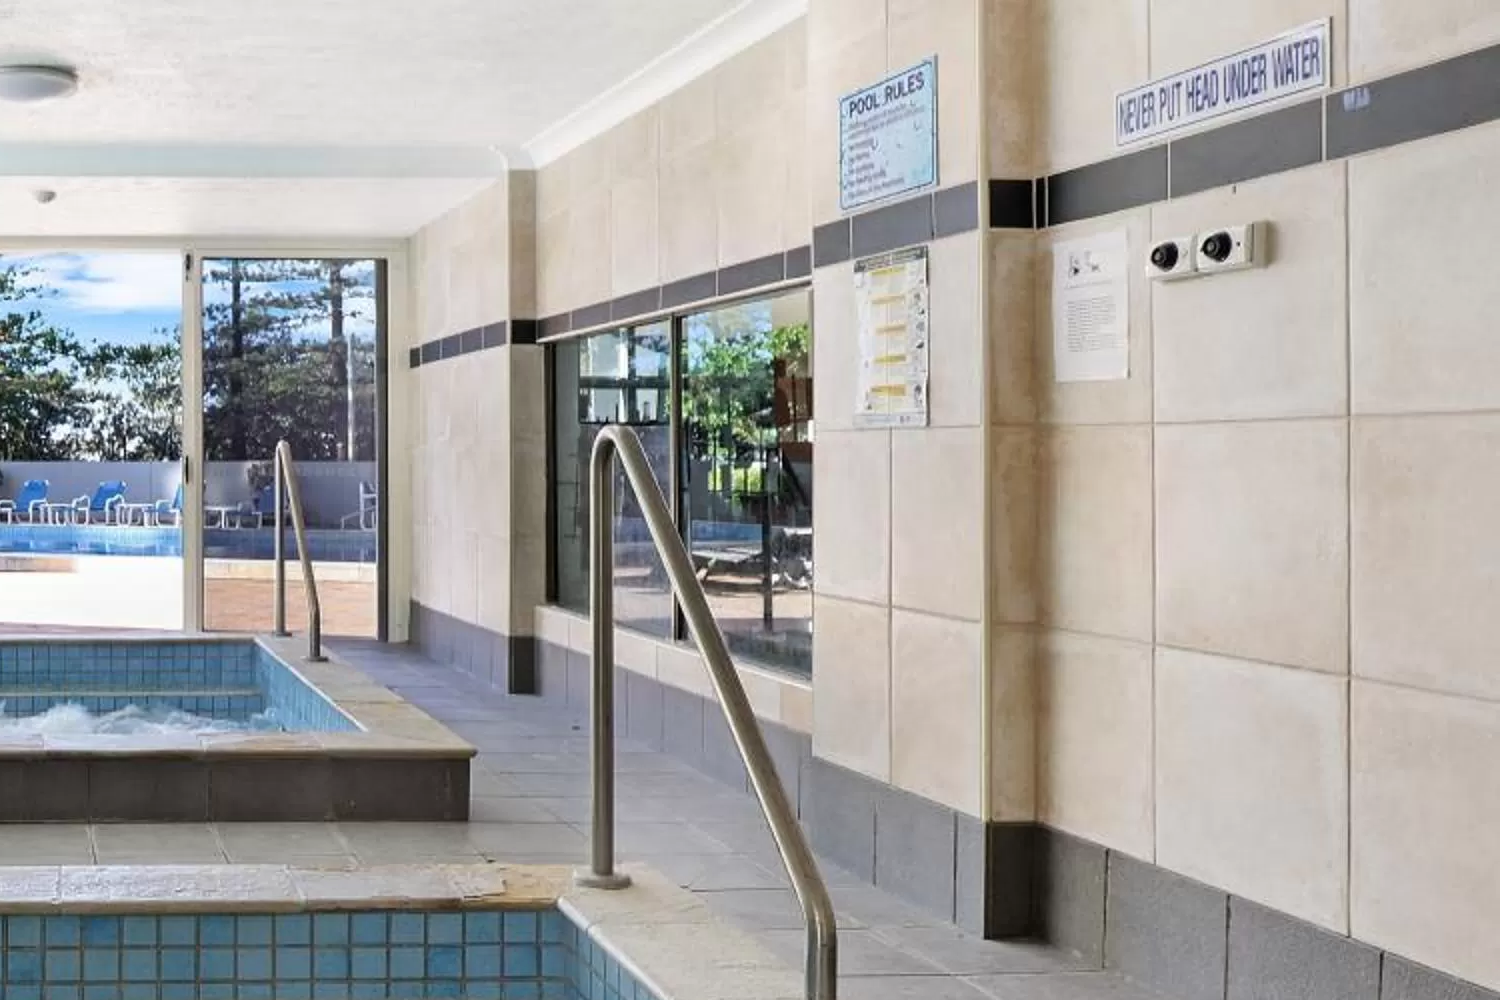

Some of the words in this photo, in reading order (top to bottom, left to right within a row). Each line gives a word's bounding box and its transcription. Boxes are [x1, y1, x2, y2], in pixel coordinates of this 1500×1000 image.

[850, 94, 880, 117] POOL
[885, 72, 924, 101] RULES
[1119, 92, 1156, 136] NEVER
[1159, 81, 1182, 123] PUT
[1186, 70, 1218, 112] HEAD
[1223, 53, 1267, 101] UNDER
[1271, 36, 1320, 89] WATER
